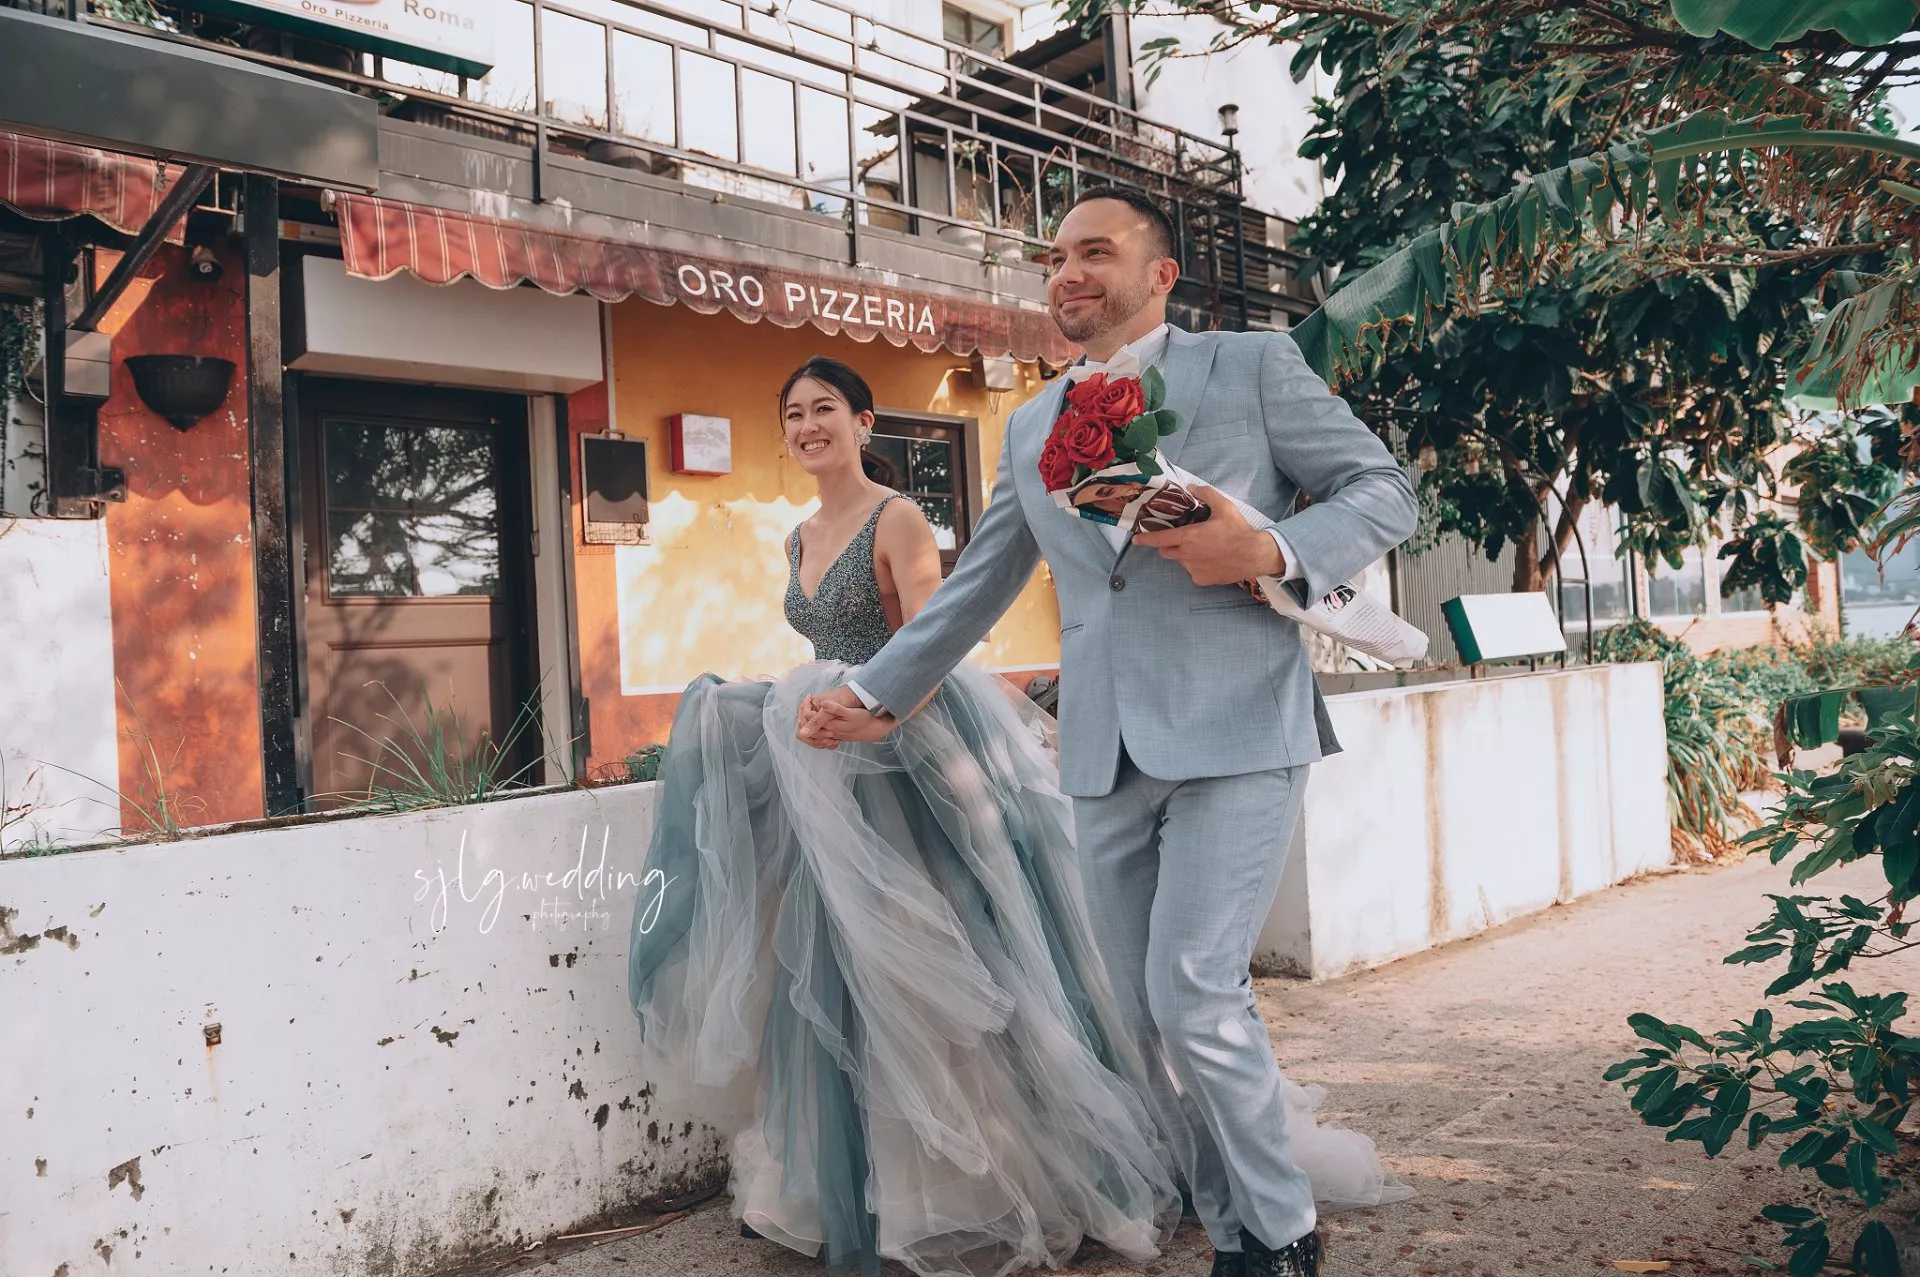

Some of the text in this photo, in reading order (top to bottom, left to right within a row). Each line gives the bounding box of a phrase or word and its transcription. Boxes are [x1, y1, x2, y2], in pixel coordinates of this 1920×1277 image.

[301, 0, 389, 30] Oro Pizzeria
[404, 0, 474, 30] Roma
[678, 264, 935, 336] ORO PIZZERIA
